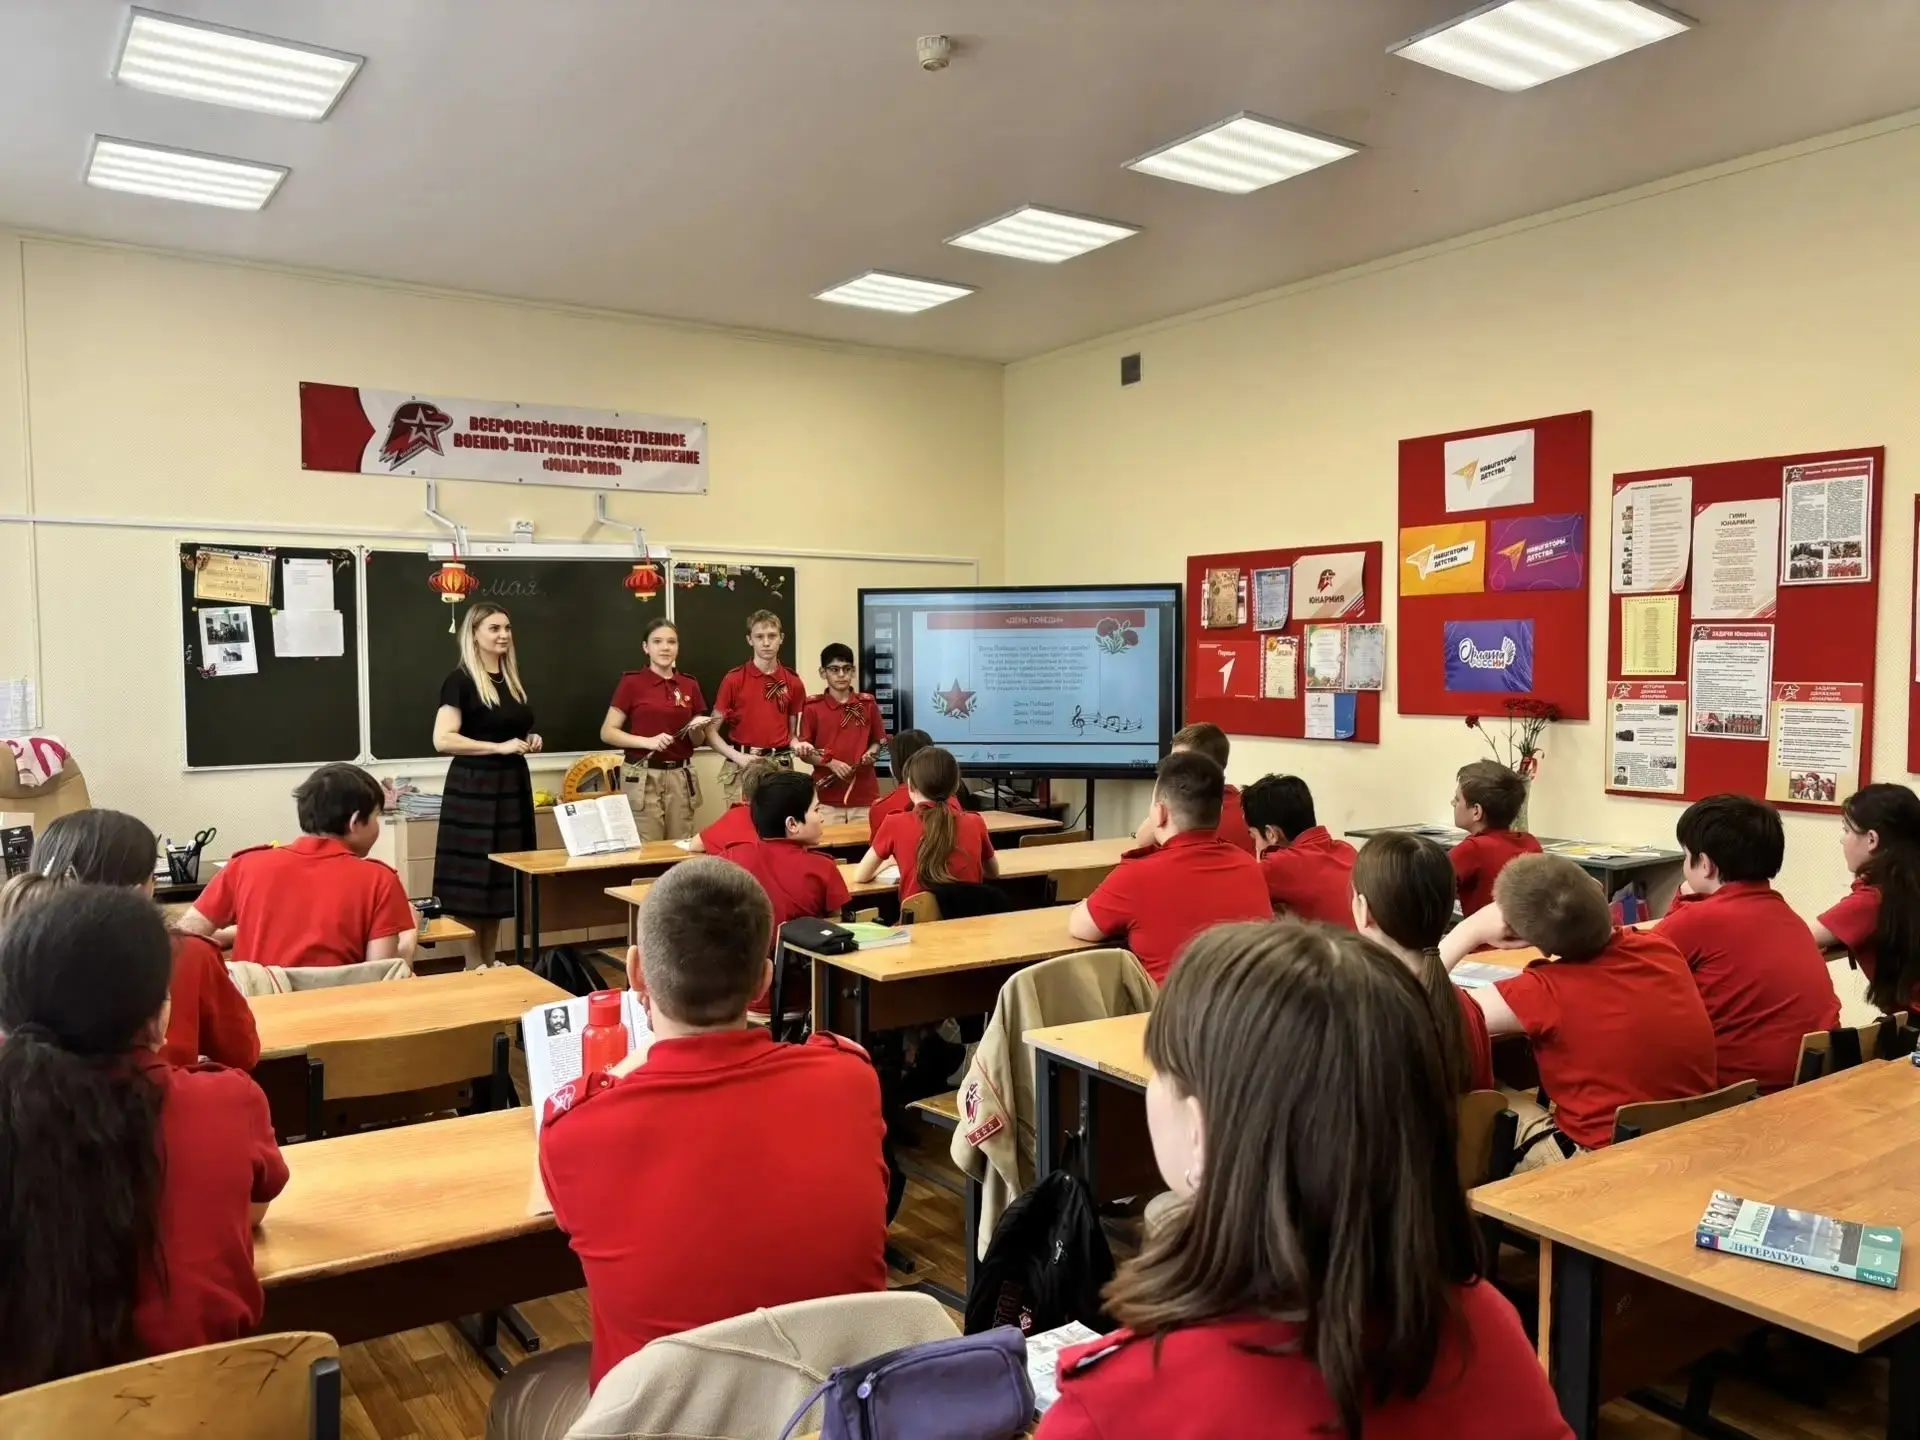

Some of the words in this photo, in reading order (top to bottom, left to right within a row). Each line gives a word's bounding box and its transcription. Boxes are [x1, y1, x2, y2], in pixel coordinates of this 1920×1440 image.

[469, 416, 584, 439] ВСЕРОССИЙСКОЕ
[586, 426, 687, 448] ОБЩЕСТВЕННОЕ
[453, 433, 630, 460] ВОЕННО-ПАТРИОТИЧЕСКОЕ
[632, 446, 700, 464] ДВИЖЕНИЕ
[542, 457, 622, 475] «ЮНАРМИЯ»
[1480, 455, 1516, 472] НАВИГАТОРЫ
[1480, 466, 1505, 480] ДЕТСТВА
[1433, 545, 1469, 560] НАВИГАТОРЫ
[1434, 556, 1458, 568] ДЕТСТВА
[1309, 595, 1345, 604] ЮНАРМИЯ
[1729, 1241, 1805, 1266] ЛИТЕРАТУРА
